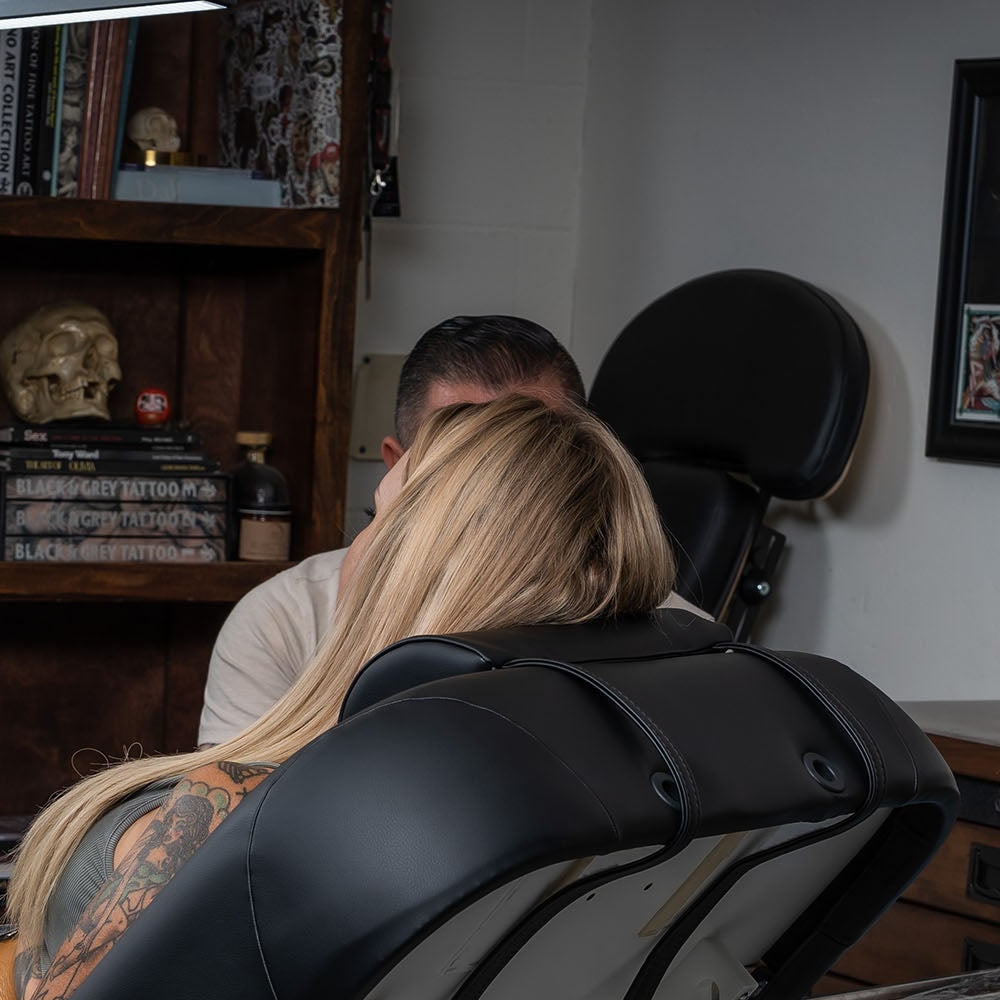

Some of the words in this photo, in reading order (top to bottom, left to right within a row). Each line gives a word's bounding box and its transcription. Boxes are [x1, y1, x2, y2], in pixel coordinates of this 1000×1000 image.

[3, 51, 16, 81] ART
[28, 52, 39, 69] OF
[26, 72, 39, 99] FINE
[0, 84, 14, 173] COLLECTION
[22, 104, 36, 153] TATTOO
[21, 153, 33, 177] ART
[23, 428, 49, 443] Sex
[51, 449, 75, 461] Tony
[75, 449, 100, 460] Ward
[15, 479, 66, 497] BLACK
[80, 479, 117, 497] GREY
[120, 480, 178, 497] TATTOO
[80, 510, 117, 527] GREY
[120, 511, 178, 527] TATTOO
[15, 543, 66, 560] BLACK
[80, 543, 117, 560] GREY
[120, 544, 178, 560] TATTOO
